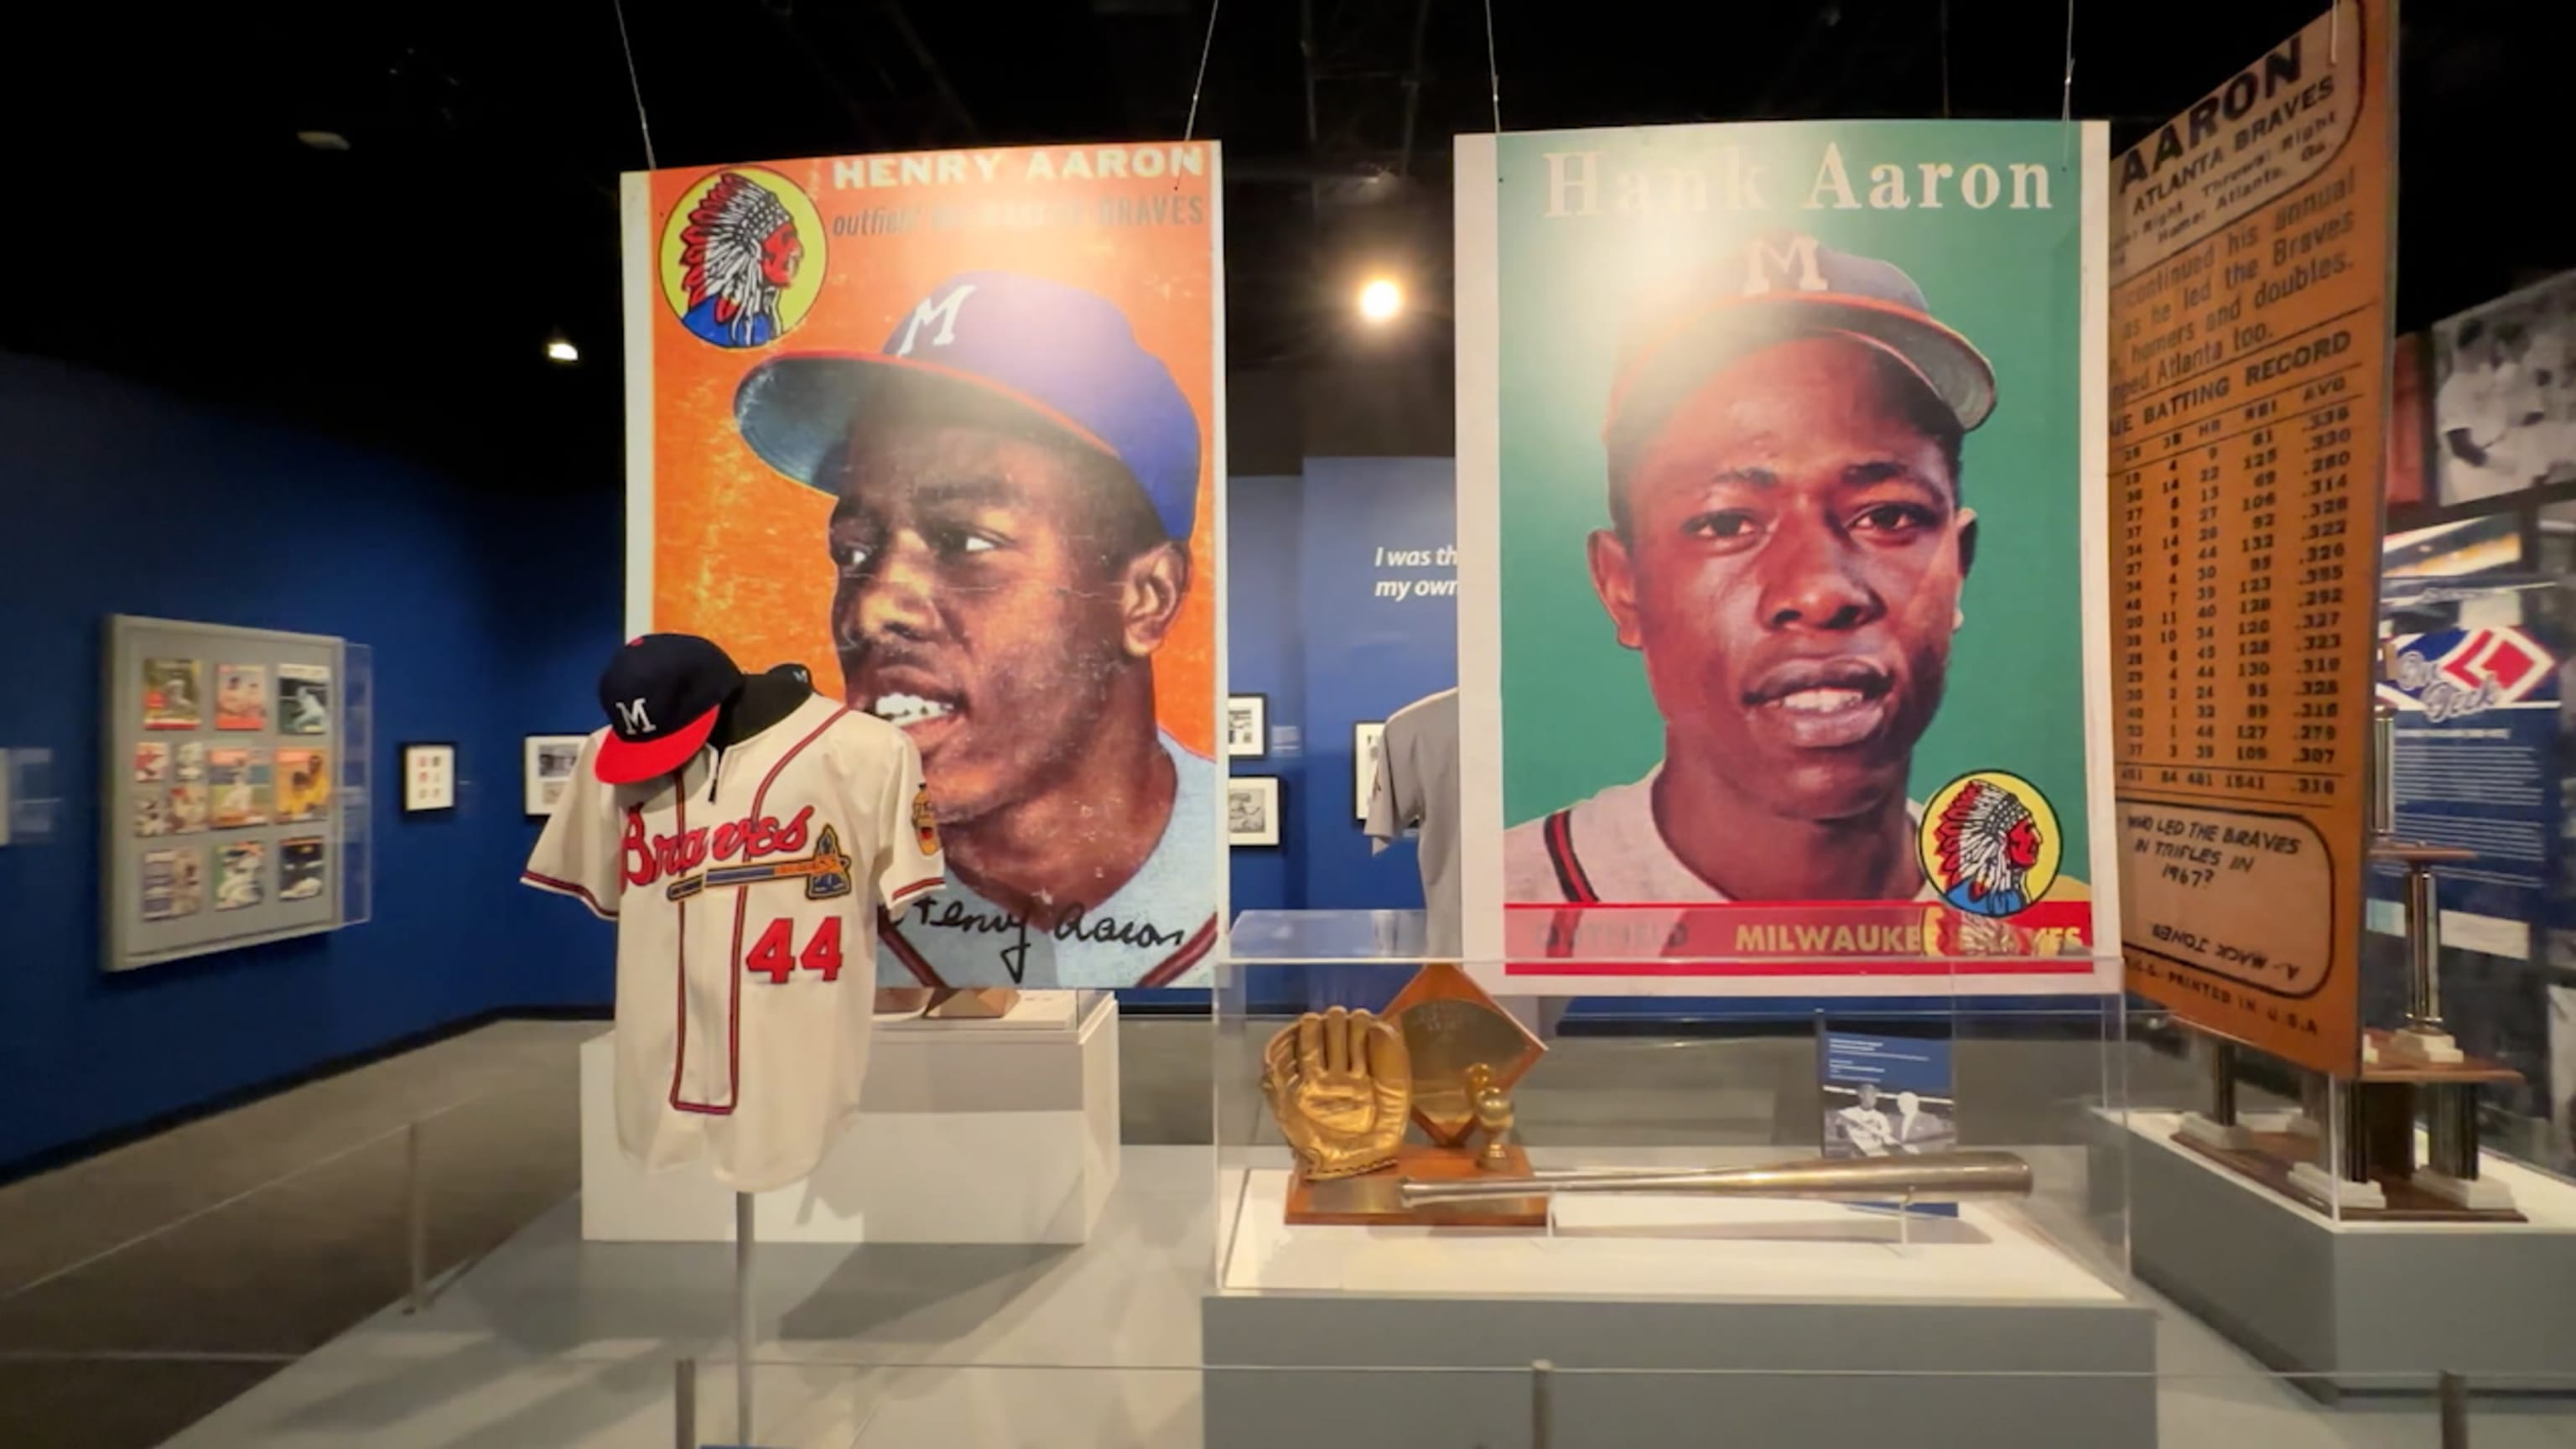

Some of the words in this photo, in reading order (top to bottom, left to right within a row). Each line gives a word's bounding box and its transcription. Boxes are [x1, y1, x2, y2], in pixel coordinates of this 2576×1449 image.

[2120, 36, 2302, 194] AARON
[834, 150, 1006, 190] HENRY
[1026, 146, 1204, 182] AARON
[2133, 148, 2225, 216] ATLANTA
[2235, 75, 2334, 153] BRAVES
[1543, 151, 1773, 218] Hank
[1803, 143, 2054, 210] Aaron
[2227, 224, 2257, 257] his
[2274, 168, 2355, 233] annual
[1744, 236, 1828, 294] M
[2184, 276, 2211, 310] led
[2225, 258, 2258, 289] the
[2272, 209, 2355, 267] Braves
[896, 283, 977, 356] M
[2205, 293, 2241, 332] and
[2143, 377, 2231, 425] BATTING
[2245, 330, 2351, 387] RECORD
[2156, 340, 2223, 386] Atlanta
[1374, 547, 1384, 567] I
[1388, 550, 1431, 567] was
[1374, 580, 1412, 602] my
[615, 697, 657, 735] M
[621, 801, 815, 895] Braves
[2157, 818, 2185, 836] LED
[2189, 821, 2218, 843] THE
[2222, 828, 2303, 855] BRAVES
[2161, 863, 2215, 890] 1967?
[2228, 855, 2255, 875] IN
[745, 916, 843, 984] 44
[1734, 923, 1940, 953] MILWAUKE
[2168, 970, 2231, 1004] PRINTED
